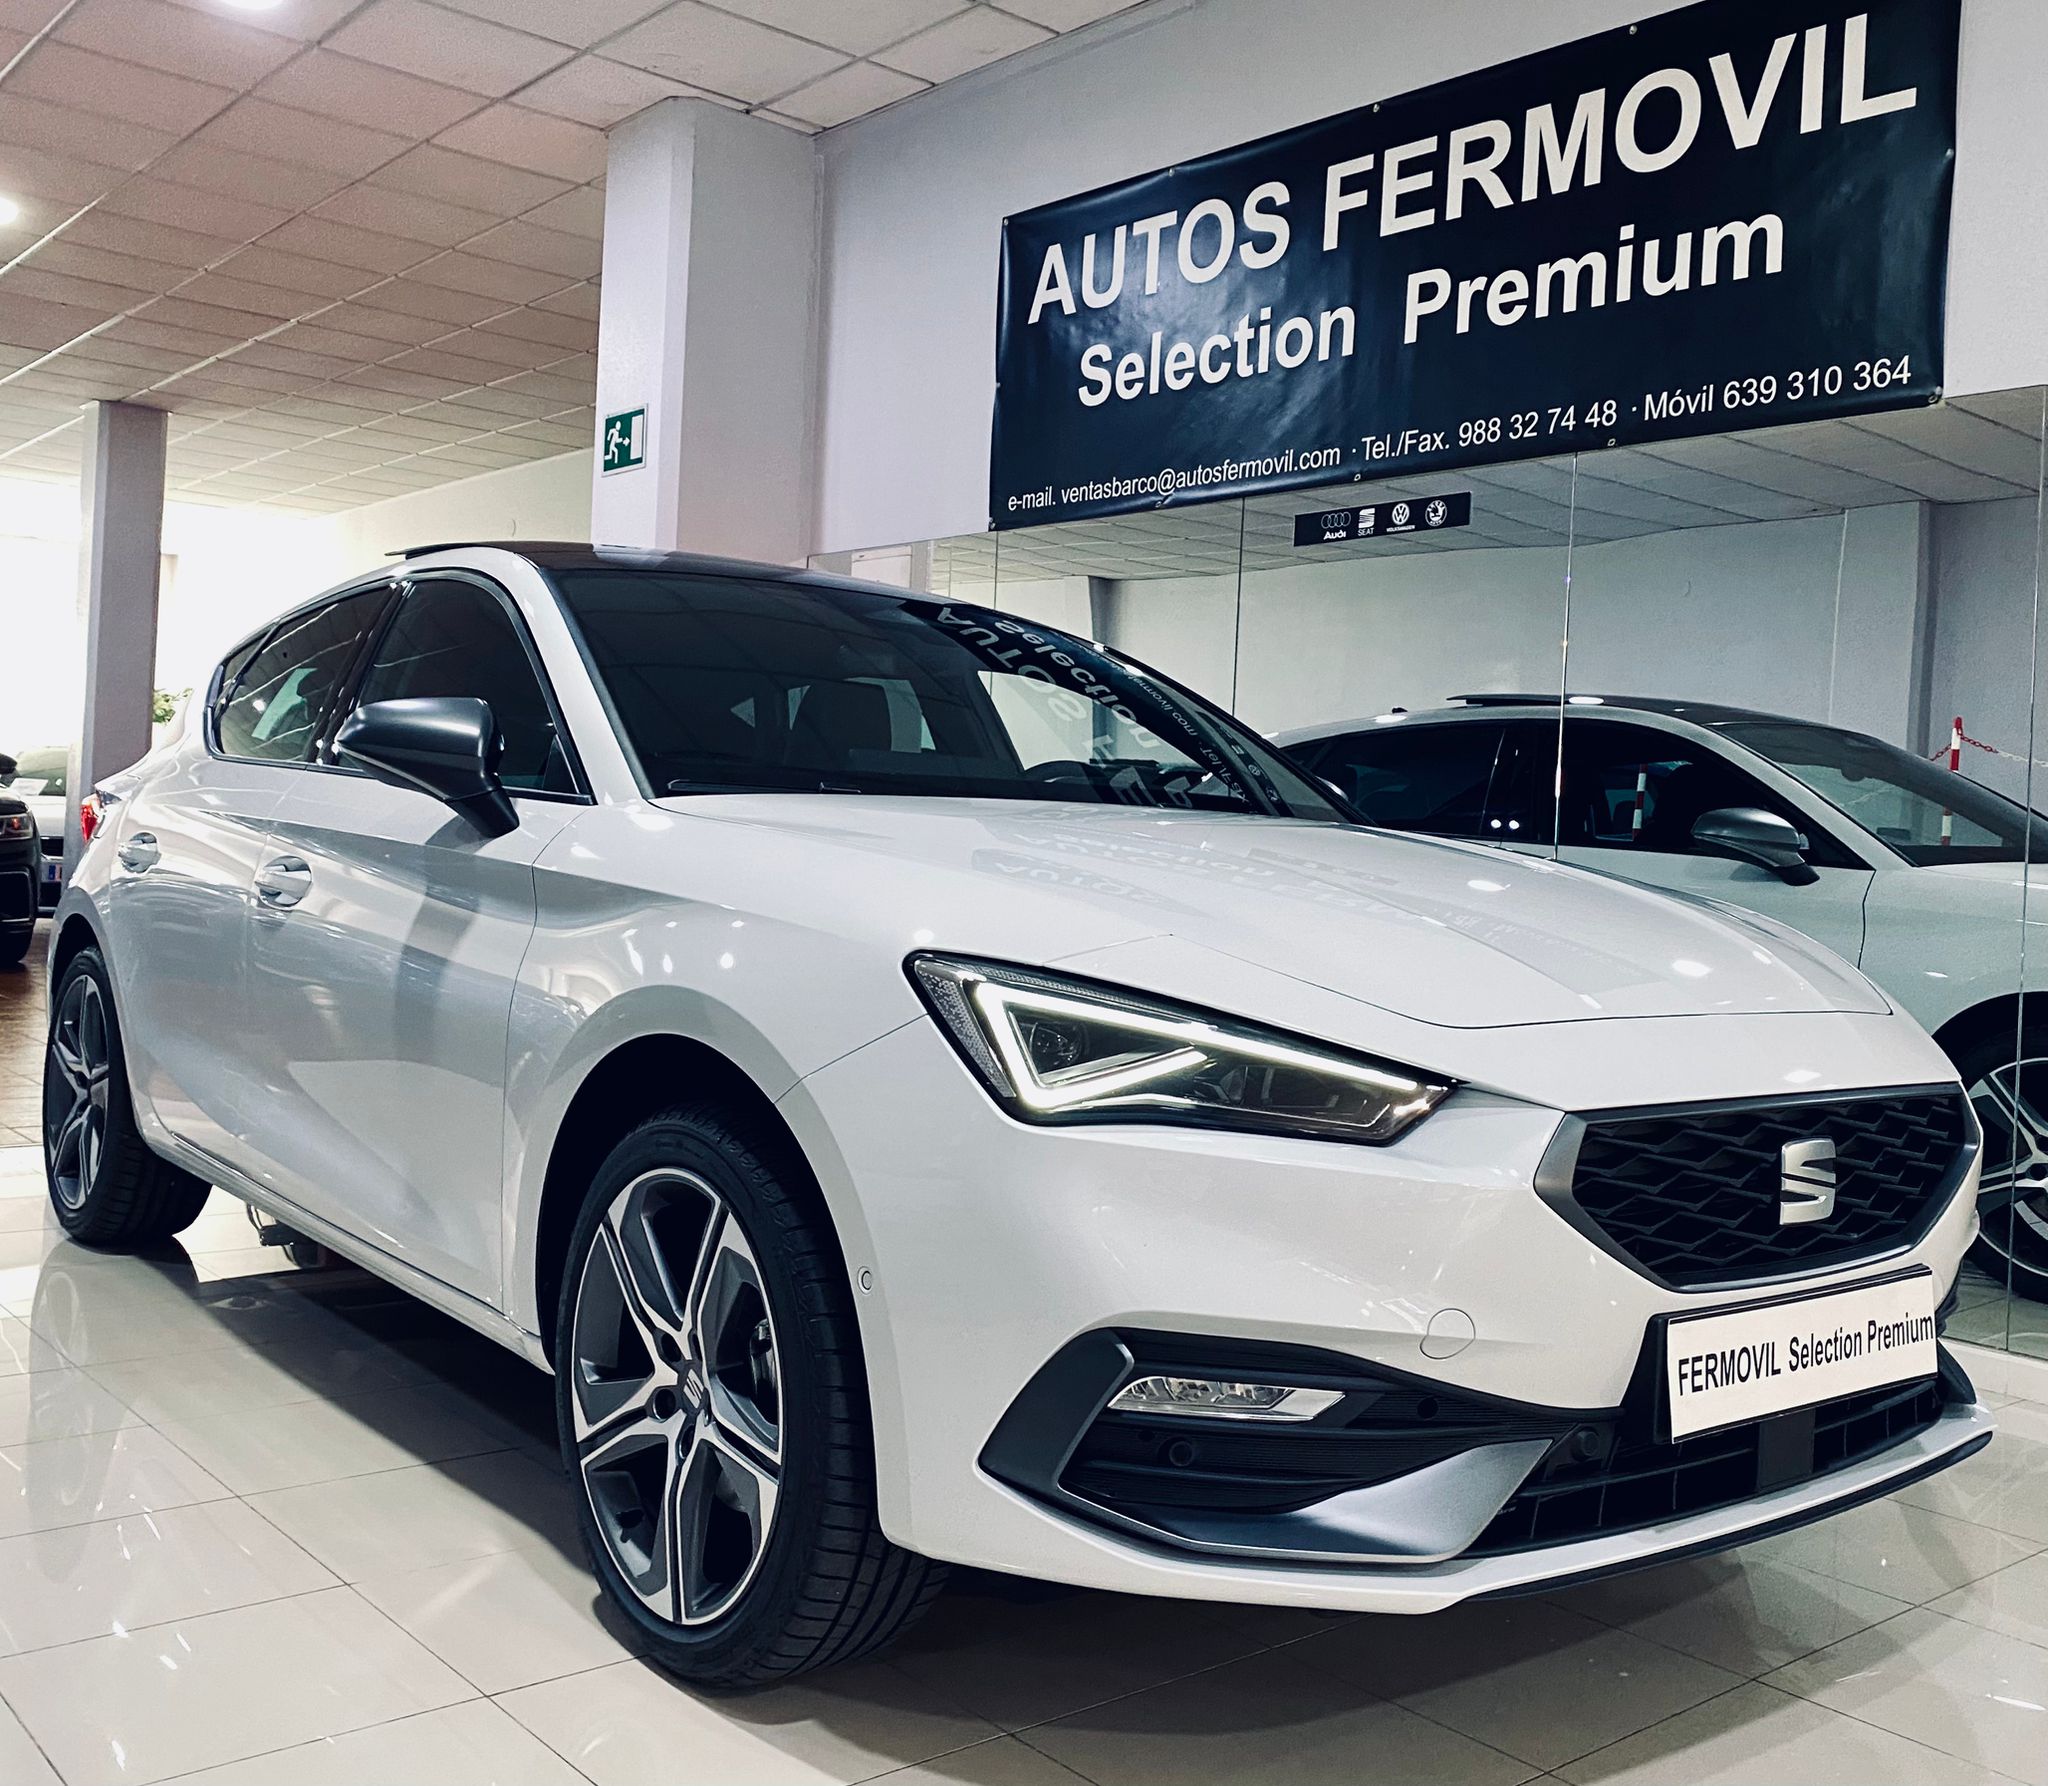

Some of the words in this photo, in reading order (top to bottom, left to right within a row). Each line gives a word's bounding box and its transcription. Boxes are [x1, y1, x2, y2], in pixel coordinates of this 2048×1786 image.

[1027, 181, 1291, 325] AUTOS
[1321, 13, 1917, 250] FERMOVIL
[1079, 305, 1356, 408] Selection
[1402, 214, 1783, 344] Premium
[1008, 486, 1056, 511] e-mail.
[1061, 447, 1341, 504] ventasbarco@autosfermovil.com
[1361, 430, 1450, 460] Tel./Fax.
[1458, 417, 1501, 447] 988
[1509, 411, 1539, 440] 32
[1547, 405, 1576, 435] 74
[1584, 400, 1617, 428] 48
[1644, 384, 1714, 421] Móvil
[1723, 375, 1777, 409] 639
[1786, 365, 1843, 400] 310
[1853, 354, 1912, 391] 364
[1323, 530, 1347, 540] Audi
[1358, 528, 1374, 537] SEAT
[1678, 1341, 1781, 1396] FERMOVIL
[1788, 1326, 1862, 1372] Selection
[1867, 1312, 1934, 1353] Premium
